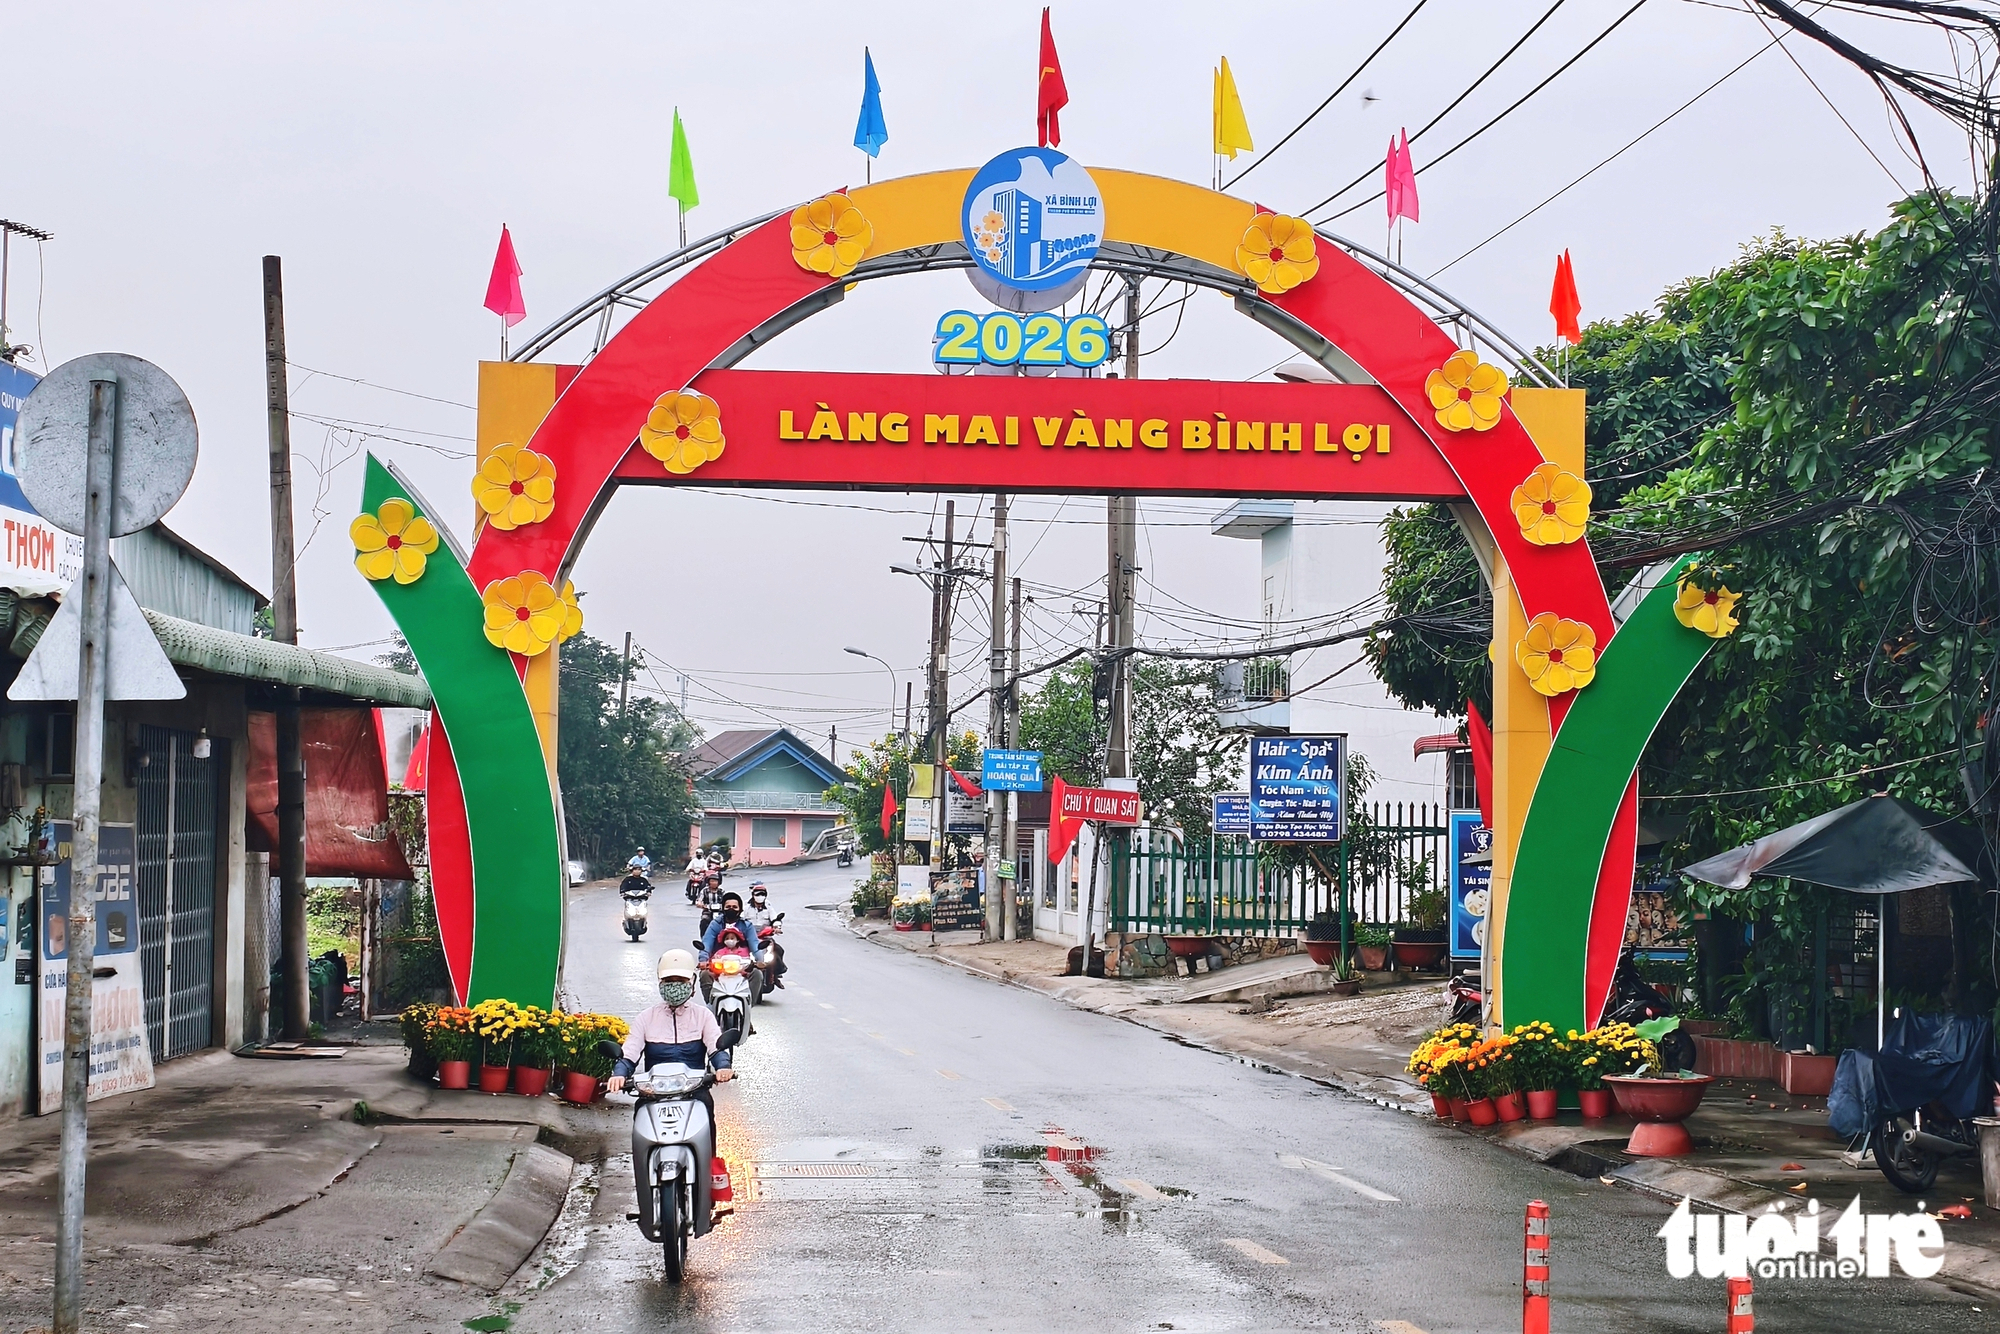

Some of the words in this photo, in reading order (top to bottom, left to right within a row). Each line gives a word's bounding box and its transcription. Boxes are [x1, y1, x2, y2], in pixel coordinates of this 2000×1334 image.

[1045, 193, 1057, 206] XÃ
[1059, 193, 1081, 206] BÌNH
[1083, 196, 1097, 209] LỢI
[936, 311, 1109, 367] 2026
[779, 402, 910, 443] LÀNG
[924, 413, 1019, 446] MAI
[1032, 409, 1169, 449] VÀNG
[1182, 412, 1302, 452] BÌNH
[1314, 422, 1391, 462] LỢI
[4, 519, 54, 573] THƠM
[65, 536, 83, 558] CHUYÊ
[1257, 741, 1290, 757] Hair
[1300, 741, 1328, 759] Spa
[987, 770, 1017, 781] HOÀNG
[1020, 773, 1035, 782] GIA
[1256, 764, 1292, 780] Kim
[1296, 760, 1334, 780] Ánh
[1012, 781, 1025, 789] Km
[1259, 784, 1279, 795] Tóc
[1280, 784, 1304, 795] Nam
[1313, 785, 1330, 795] Nữ
[1064, 790, 1082, 812] CHÚ
[1085, 791, 1092, 813] Ý
[1094, 796, 1118, 815] QUAN
[1121, 795, 1138, 817] SÁT
[1463, 876, 1477, 885] TÁI
[1477, 877, 1490, 885] SIN
[91, 986, 140, 1035] HƠM
